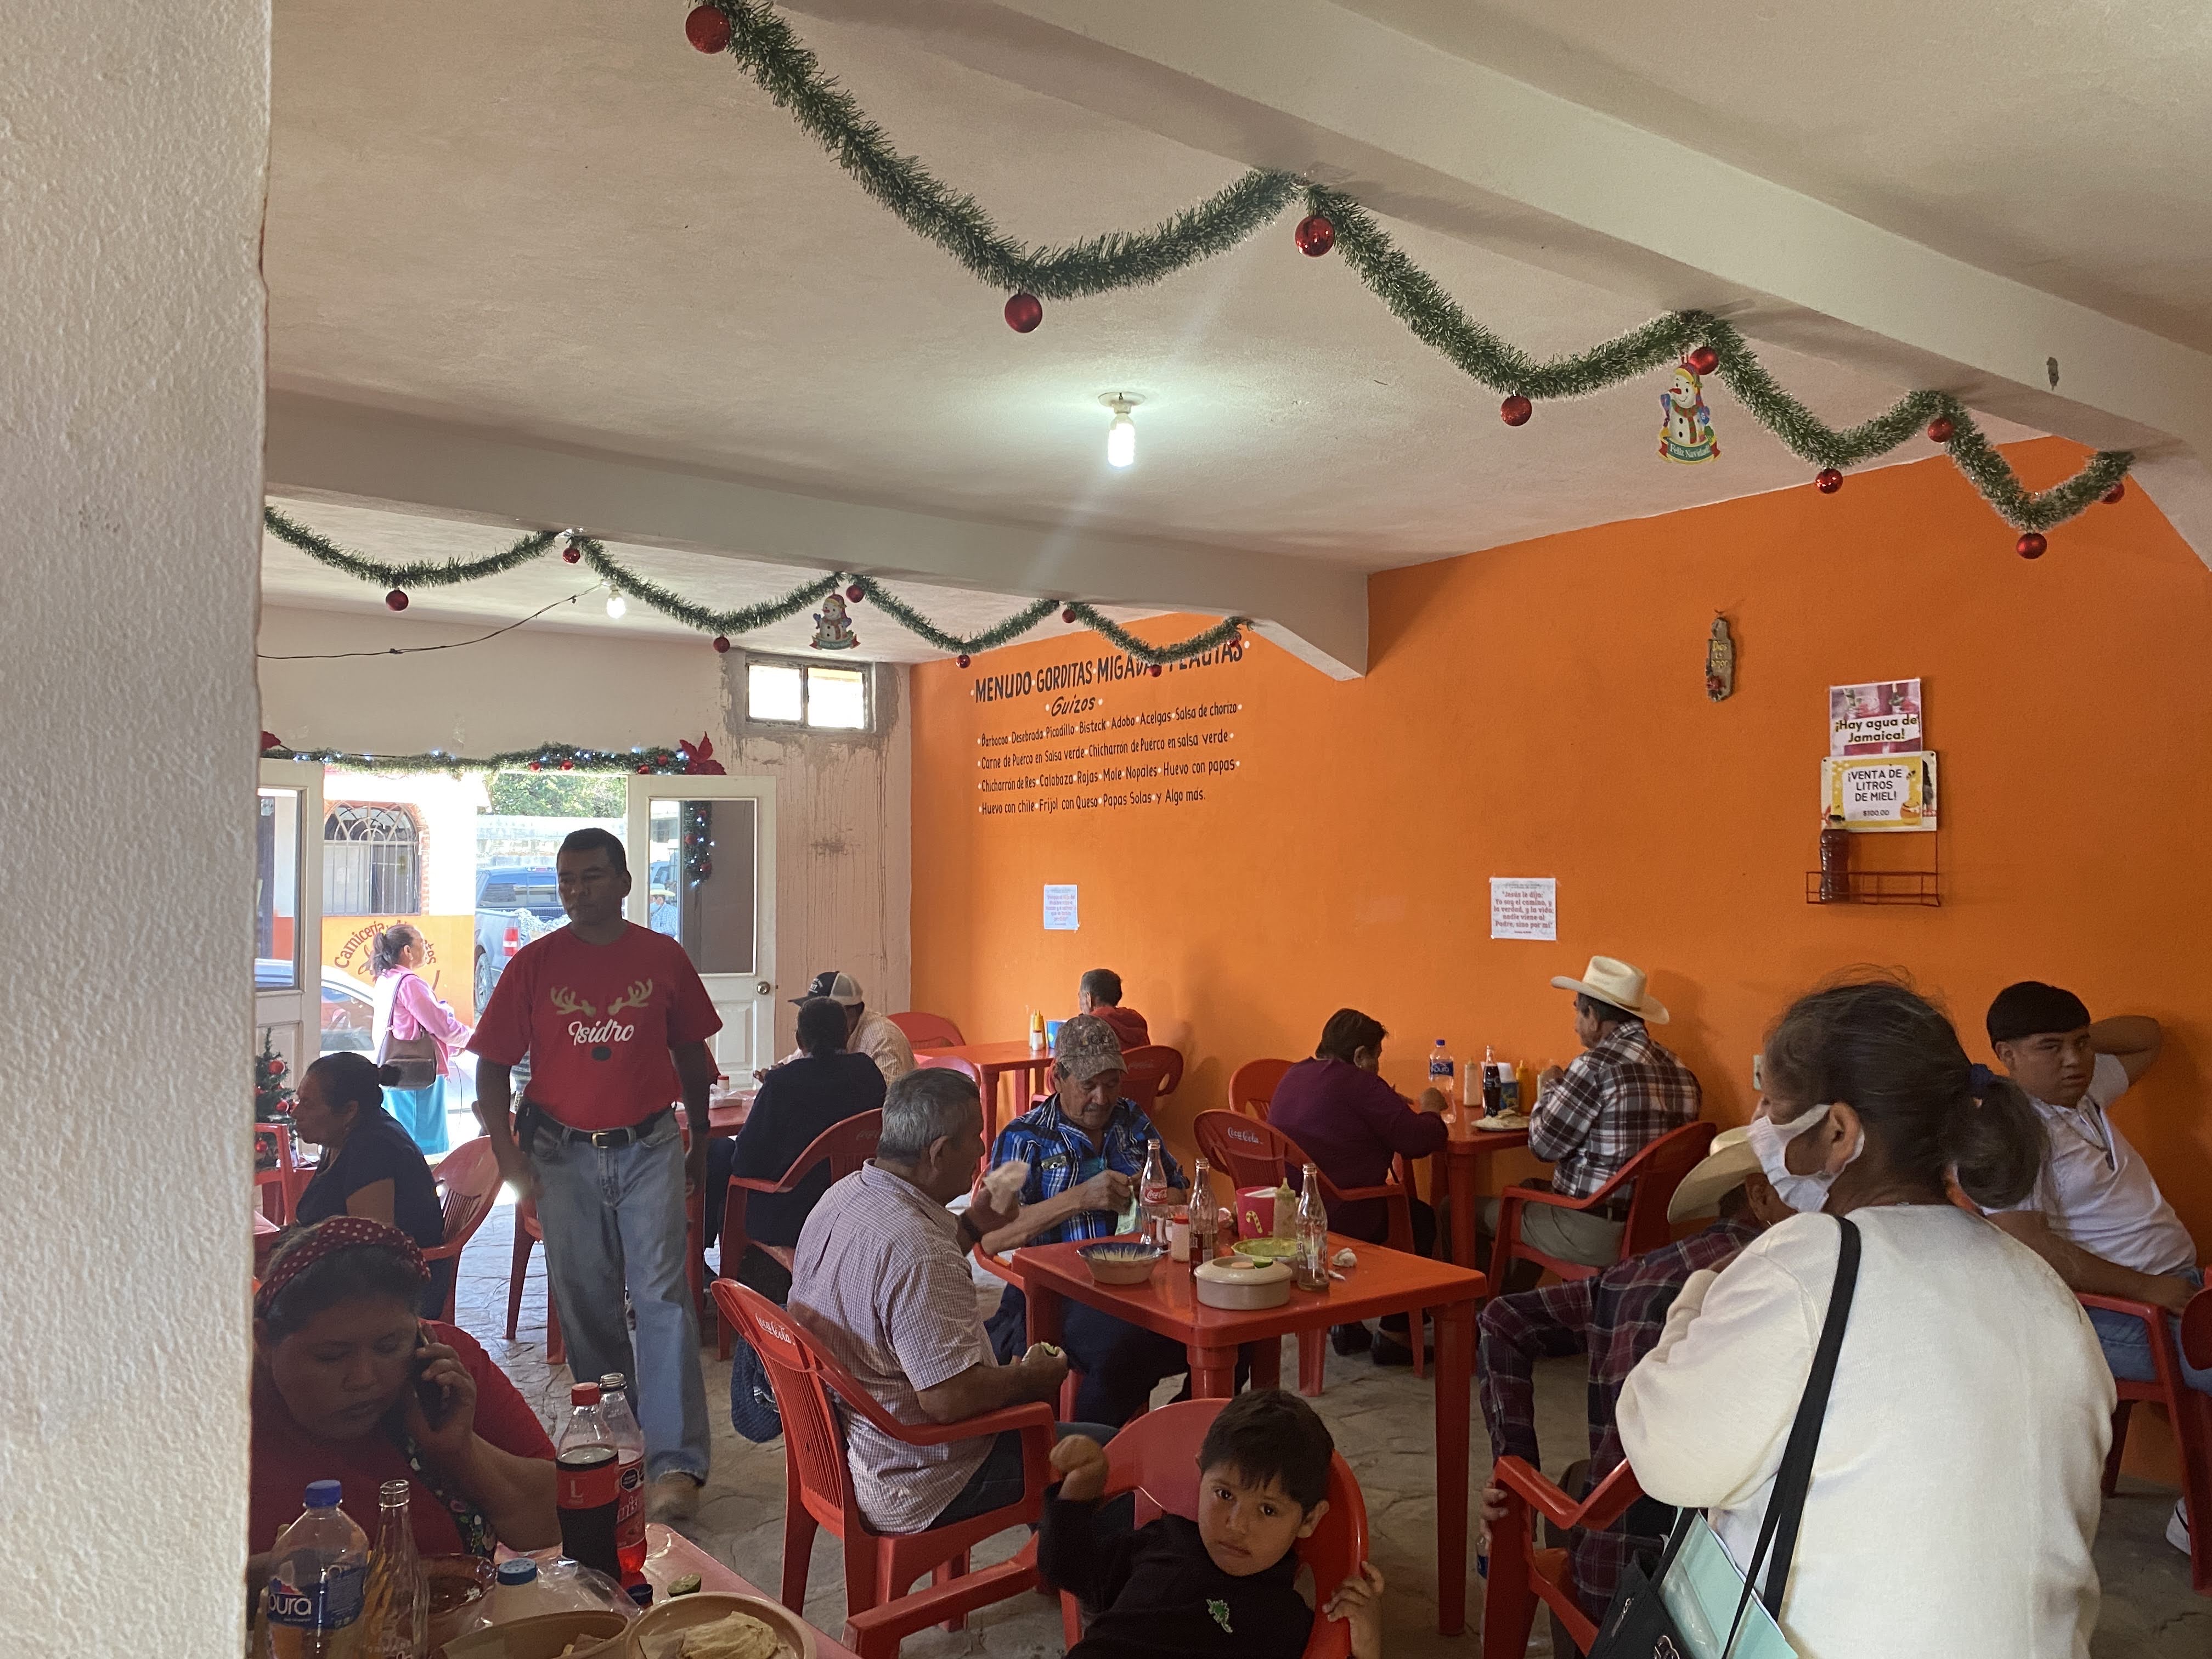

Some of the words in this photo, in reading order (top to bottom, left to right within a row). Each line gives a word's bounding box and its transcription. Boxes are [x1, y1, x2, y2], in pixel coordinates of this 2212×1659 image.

[975, 670, 1032, 703] MENUDO
[1036, 660, 1093, 693] GORDITAS
[981, 733, 1008, 747] Barbacoa
[1011, 729, 1043, 744] Desebrada
[1046, 723, 1074, 738] Picadillo
[1079, 718, 1106, 734] Bisteck
[1111, 715, 1135, 730] Adobo
[1140, 711, 1171, 726] Acelgas
[1175, 706, 1196, 720] Salsa
[1198, 703, 1207, 715] de
[1210, 701, 1237, 716] chorizo
[1835, 720, 1863, 732] ¡Hay
[1866, 719, 1898, 730] agua
[1902, 714, 1917, 725] de
[1848, 728, 1905, 743] Jamaica!
[981, 757, 1001, 769] Carne
[1003, 754, 1011, 768] de
[1035, 753, 1042, 764] en
[1045, 751, 1062, 763] Salsa
[1064, 746, 1085, 759] verde
[1131, 739, 1139, 752] de
[1167, 738, 1176, 748] en
[1178, 733, 1198, 747] salsa
[1202, 729, 1228, 744] verde
[1017, 777, 1024, 789] de
[1025, 775, 1036, 789] Res
[1040, 774, 1073, 787] Calabaza
[1077, 770, 1098, 786] Rajas
[1103, 768, 1121, 782] Mole
[1164, 761, 1188, 776] Huevo
[1192, 762, 1205, 774] con
[1209, 759, 1235, 775] papas
[1848, 770, 1886, 782] ¡VENTA
[1889, 769, 1902, 778] DE
[1856, 781, 1893, 791] LITROS
[982, 802, 1002, 815] Huevo
[1005, 802, 1015, 813] con
[1018, 799, 1035, 813] chile
[1039, 797, 1058, 814] Frijol
[1062, 799, 1074, 810] con
[1076, 795, 1098, 810] Queso
[1103, 793, 1127, 810] Papas
[1130, 791, 1152, 804] Solas
[1156, 792, 1162, 804] y
[1165, 788, 1183, 806] Algo
[1855, 793, 1868, 802] DE
[1870, 791, 1897, 801] MIEL!
[568, 1018, 634, 1046] Isidro
